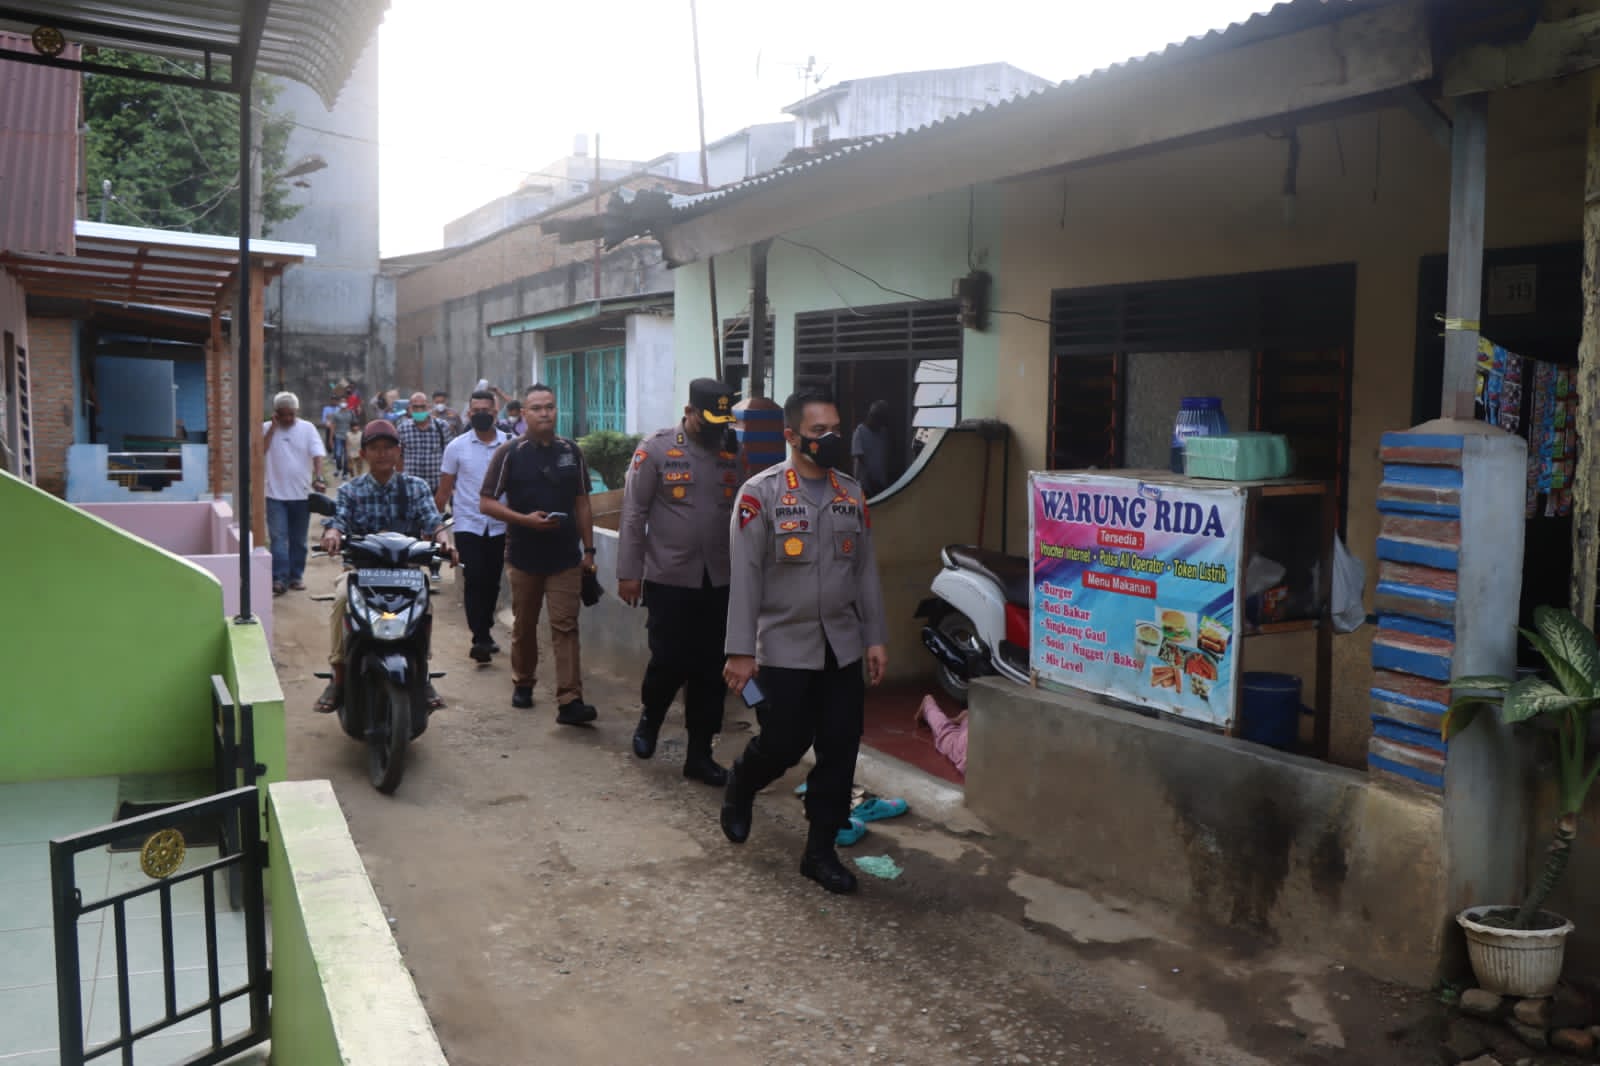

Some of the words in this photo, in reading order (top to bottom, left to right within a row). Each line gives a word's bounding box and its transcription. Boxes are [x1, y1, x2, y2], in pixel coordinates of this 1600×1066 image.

[1040, 490, 1147, 528] WARUNG
[1153, 500, 1225, 538] RIDA
[1100, 530, 1137, 546] Tersedia
[1040, 540, 1065, 558] Voucher
[1099, 548, 1119, 568] Pulsa
[1119, 551, 1131, 569] All
[1131, 553, 1165, 575] Operator
[1173, 559, 1198, 579] Token
[1199, 561, 1227, 584] Listrik
[1043, 581, 1073, 600] Burger
[1087, 573, 1111, 588] Menu
[1112, 577, 1152, 594] Makanan
[1063, 603, 1091, 621] Bakar
[1045, 617, 1083, 640] Singkong
[1085, 627, 1106, 643] Gaul
[1072, 641, 1105, 661] Nugget
[1060, 656, 1084, 673] Level
